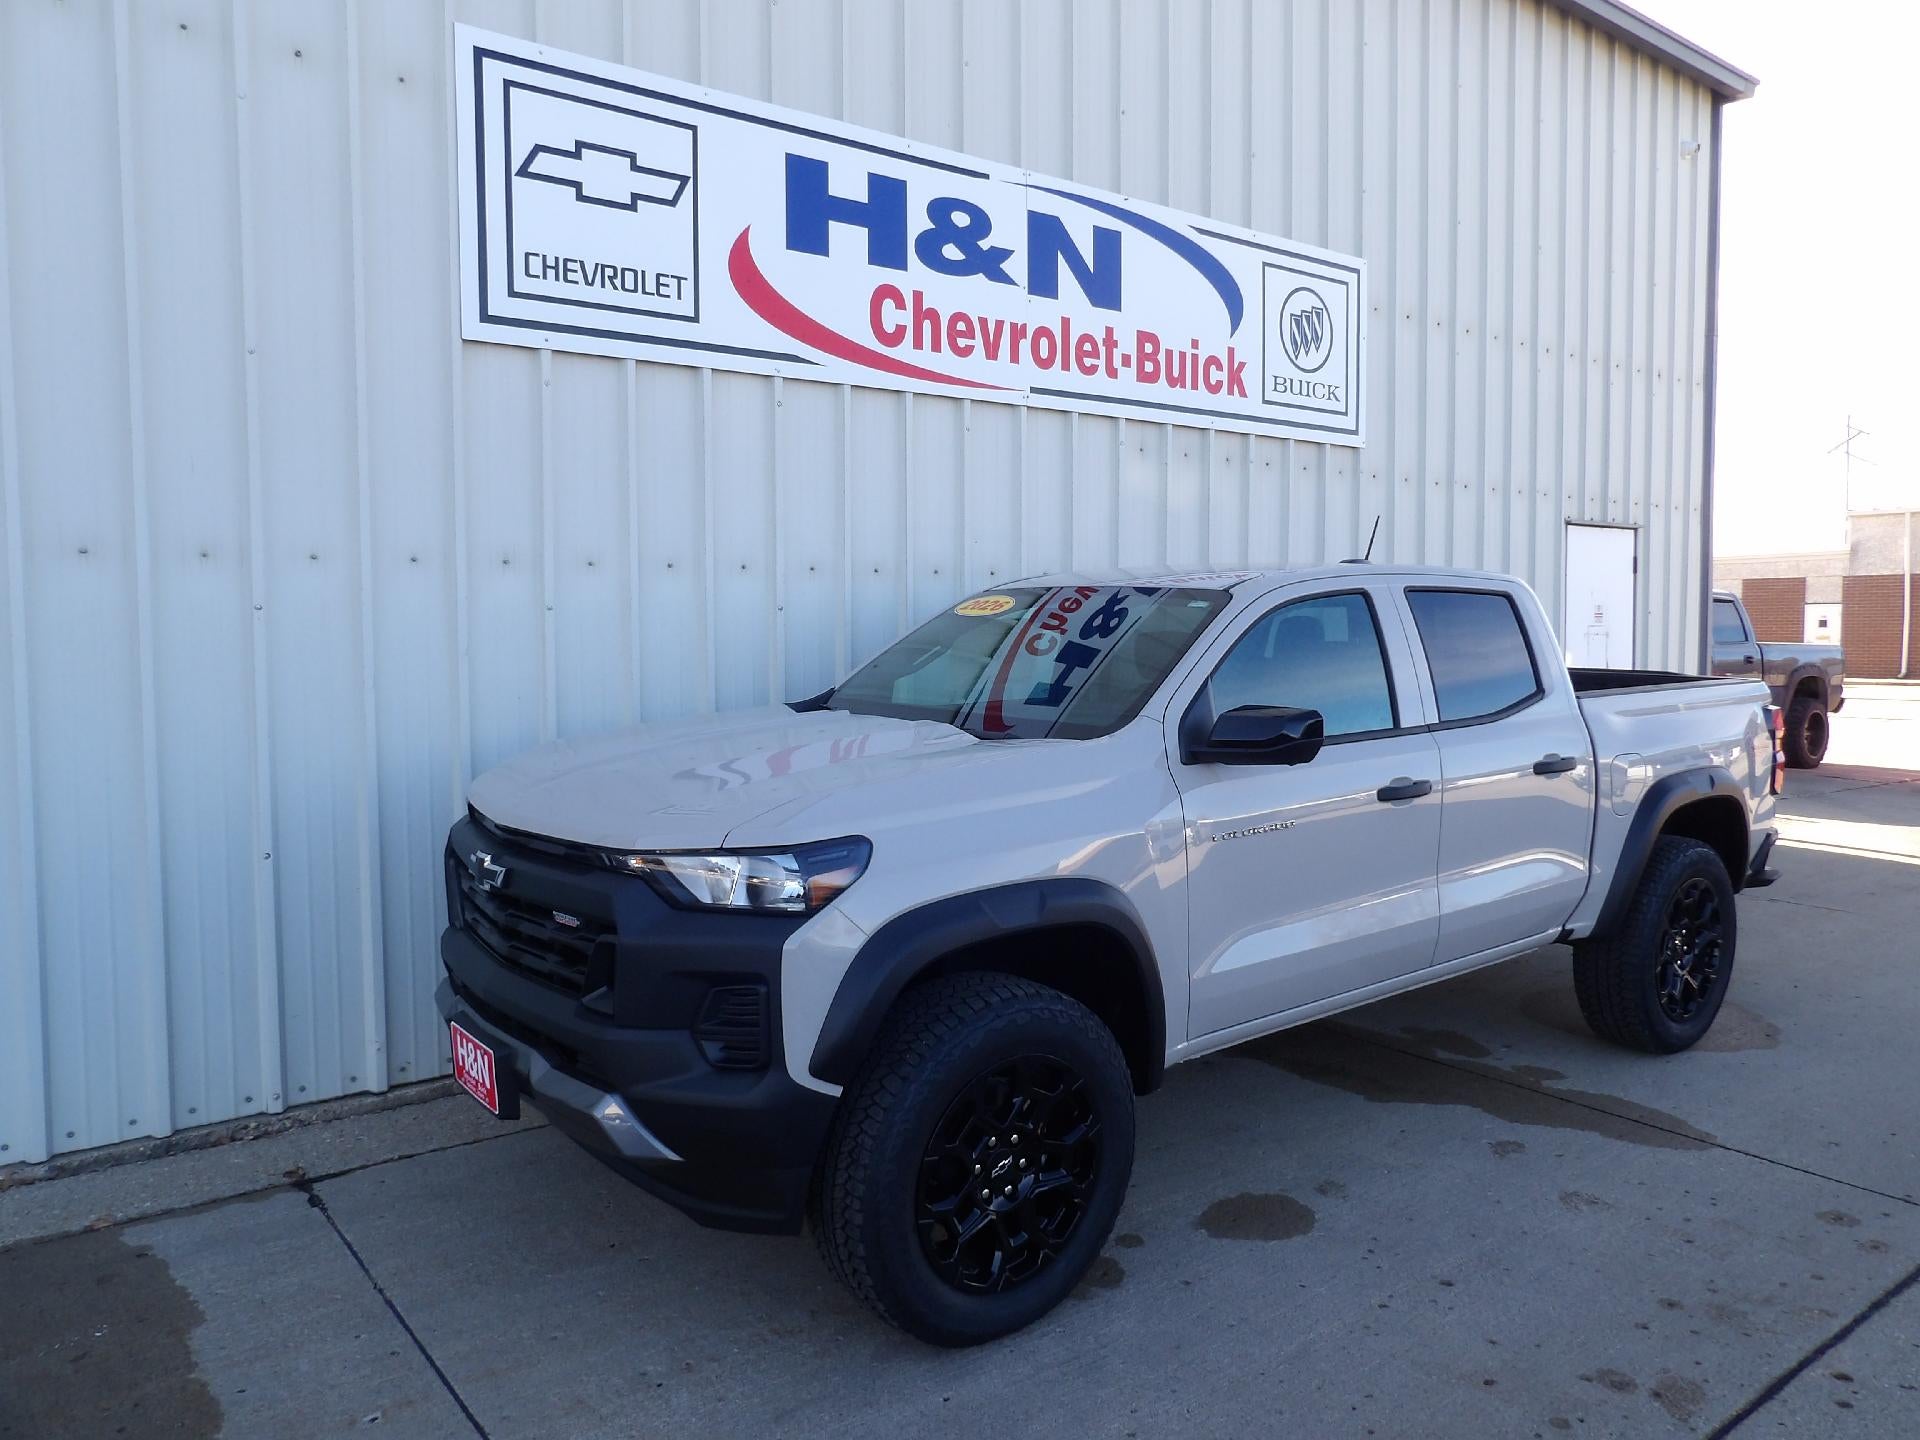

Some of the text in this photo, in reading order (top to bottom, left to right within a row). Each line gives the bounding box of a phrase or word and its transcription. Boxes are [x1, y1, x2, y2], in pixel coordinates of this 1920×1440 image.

[785, 152, 1122, 312] H&N
[524, 251, 688, 300] CHEVROLET
[869, 283, 1248, 398] Chevrolet-Buick
[1272, 375, 1341, 402] BUICK
[959, 599, 1010, 611] 2026
[456, 1033, 491, 1089] H&N
